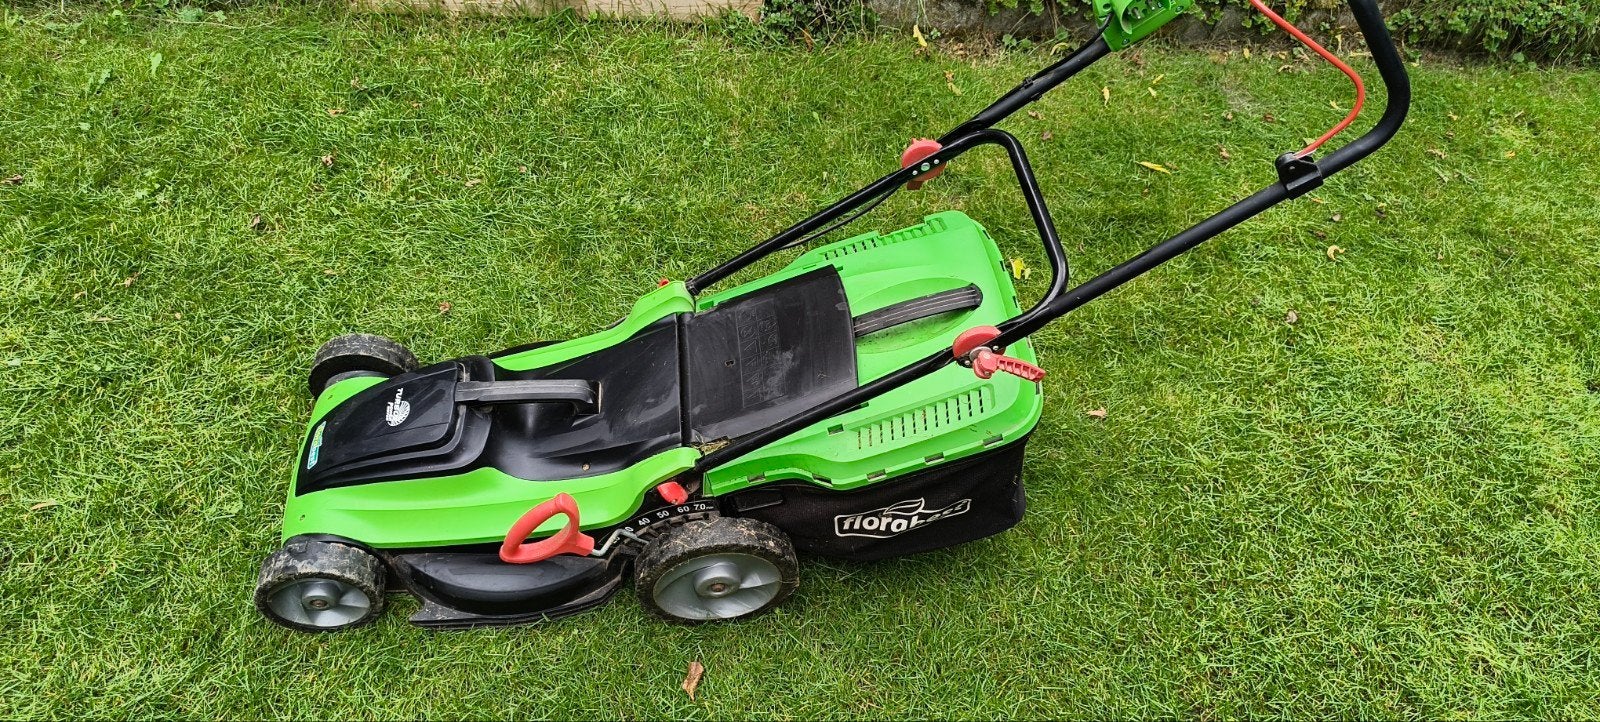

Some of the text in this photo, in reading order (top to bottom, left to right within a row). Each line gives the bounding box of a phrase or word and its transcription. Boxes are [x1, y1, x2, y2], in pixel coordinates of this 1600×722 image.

[393, 387, 404, 417] TURBO
[637, 517, 651, 527] 40
[656, 510, 670, 519] 50
[677, 505, 690, 514] 60
